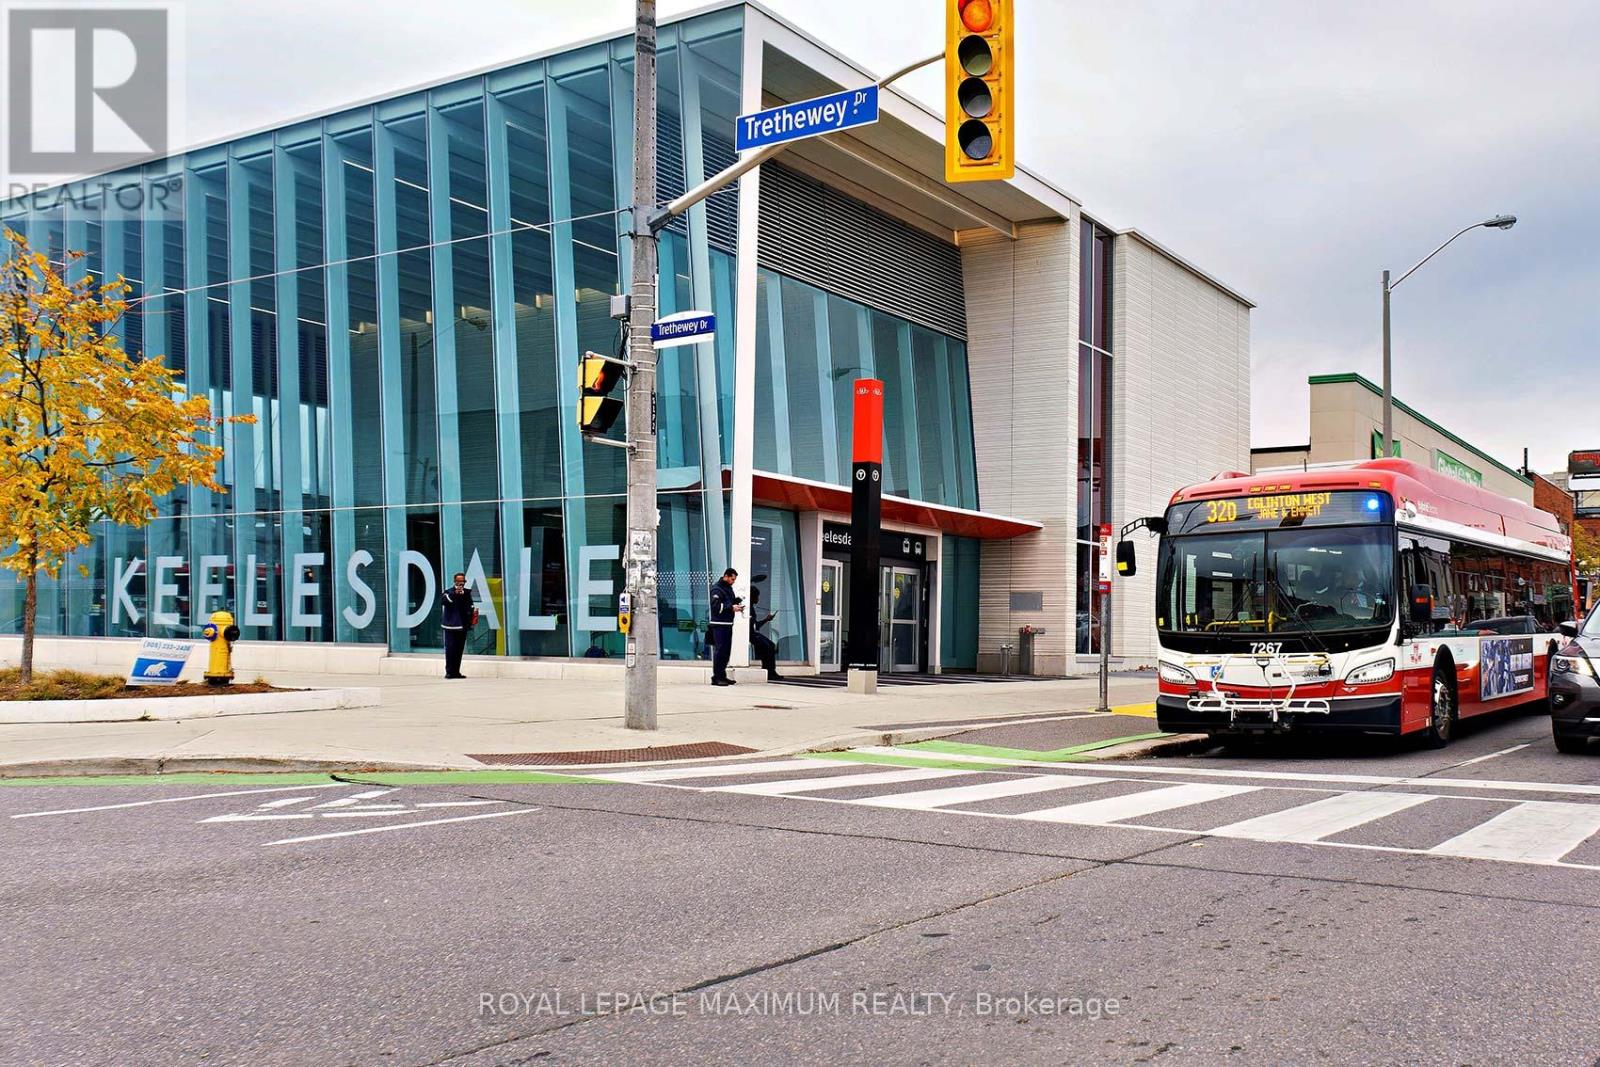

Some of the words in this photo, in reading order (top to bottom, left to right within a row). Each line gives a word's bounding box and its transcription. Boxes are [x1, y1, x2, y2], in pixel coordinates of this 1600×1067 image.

[745, 100, 848, 140] Trethewey
[855, 91, 867, 104] Dr
[658, 321, 699, 335] Trethewey
[700, 320, 708, 329] Dr
[1247, 494, 1300, 510] EGLINTON
[1303, 493, 1331, 505] WEST
[1257, 507, 1279, 519] JANE
[1281, 509, 1288, 519] &
[111, 544, 620, 632] KEELESDALE
[1250, 642, 1283, 654] 7267
